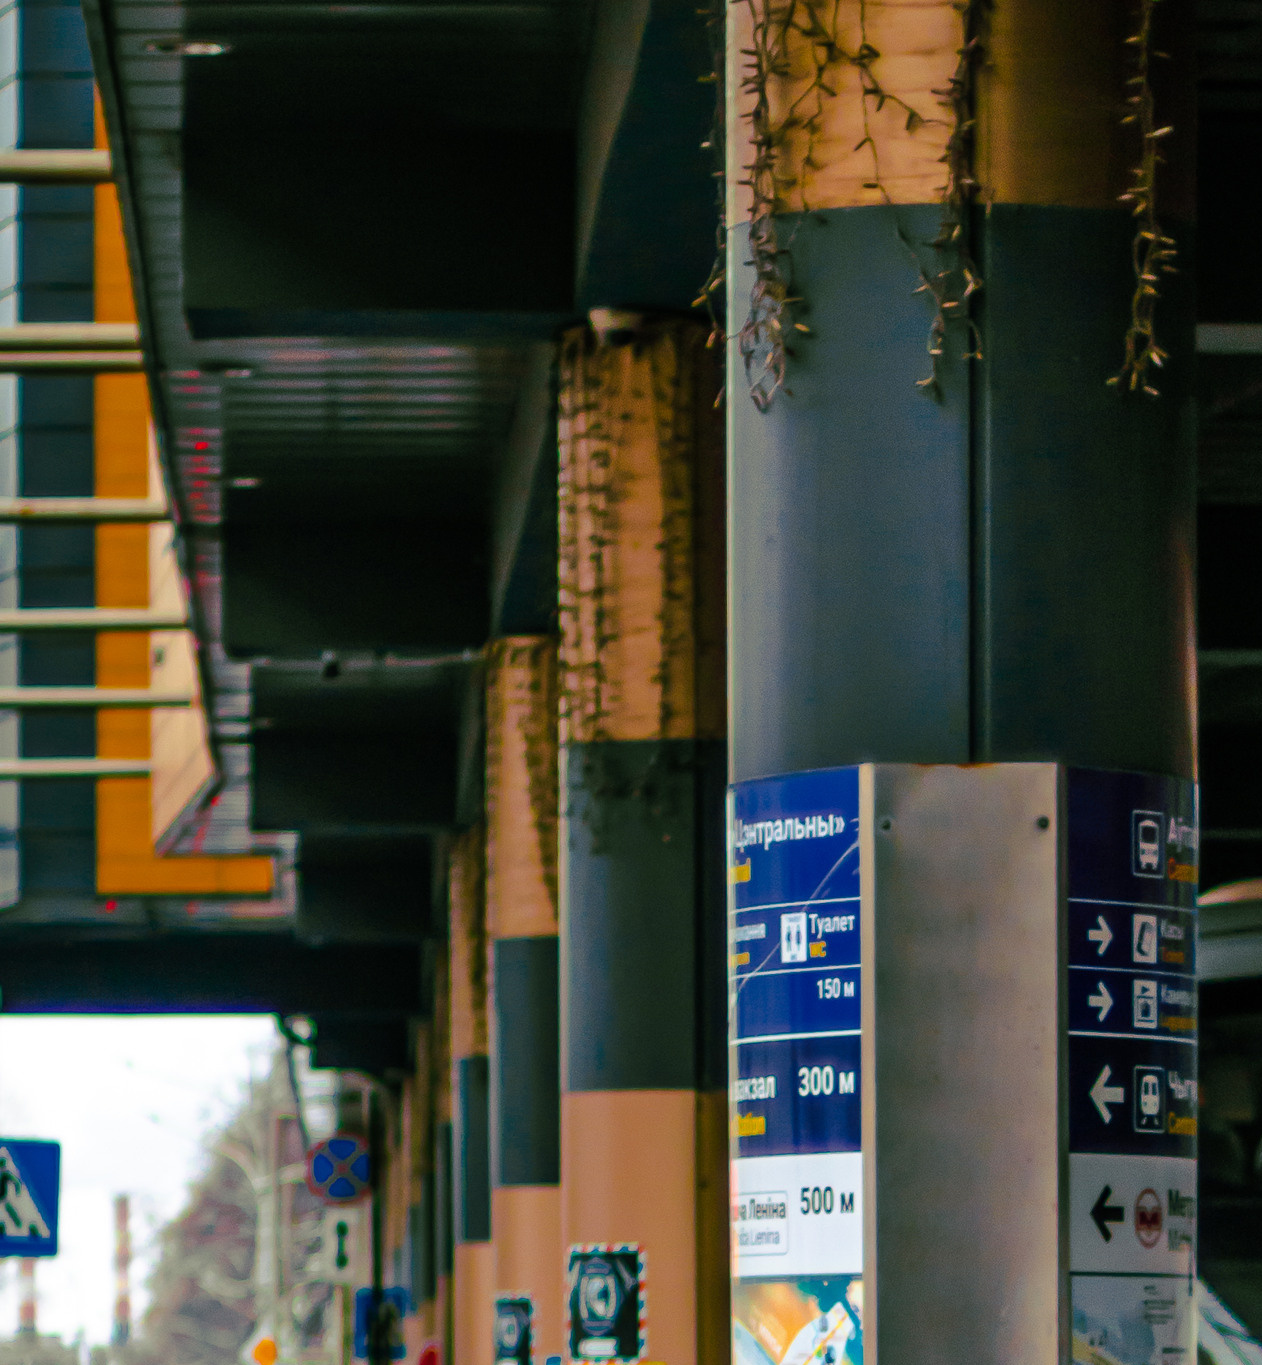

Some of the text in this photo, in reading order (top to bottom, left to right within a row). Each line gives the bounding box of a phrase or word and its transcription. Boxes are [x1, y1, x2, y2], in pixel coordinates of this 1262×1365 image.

[808, 912, 856, 940] Туалет
[816, 977, 842, 1000] 150
[797, 1065, 835, 1097] 300
[800, 1186, 835, 1216] 500
